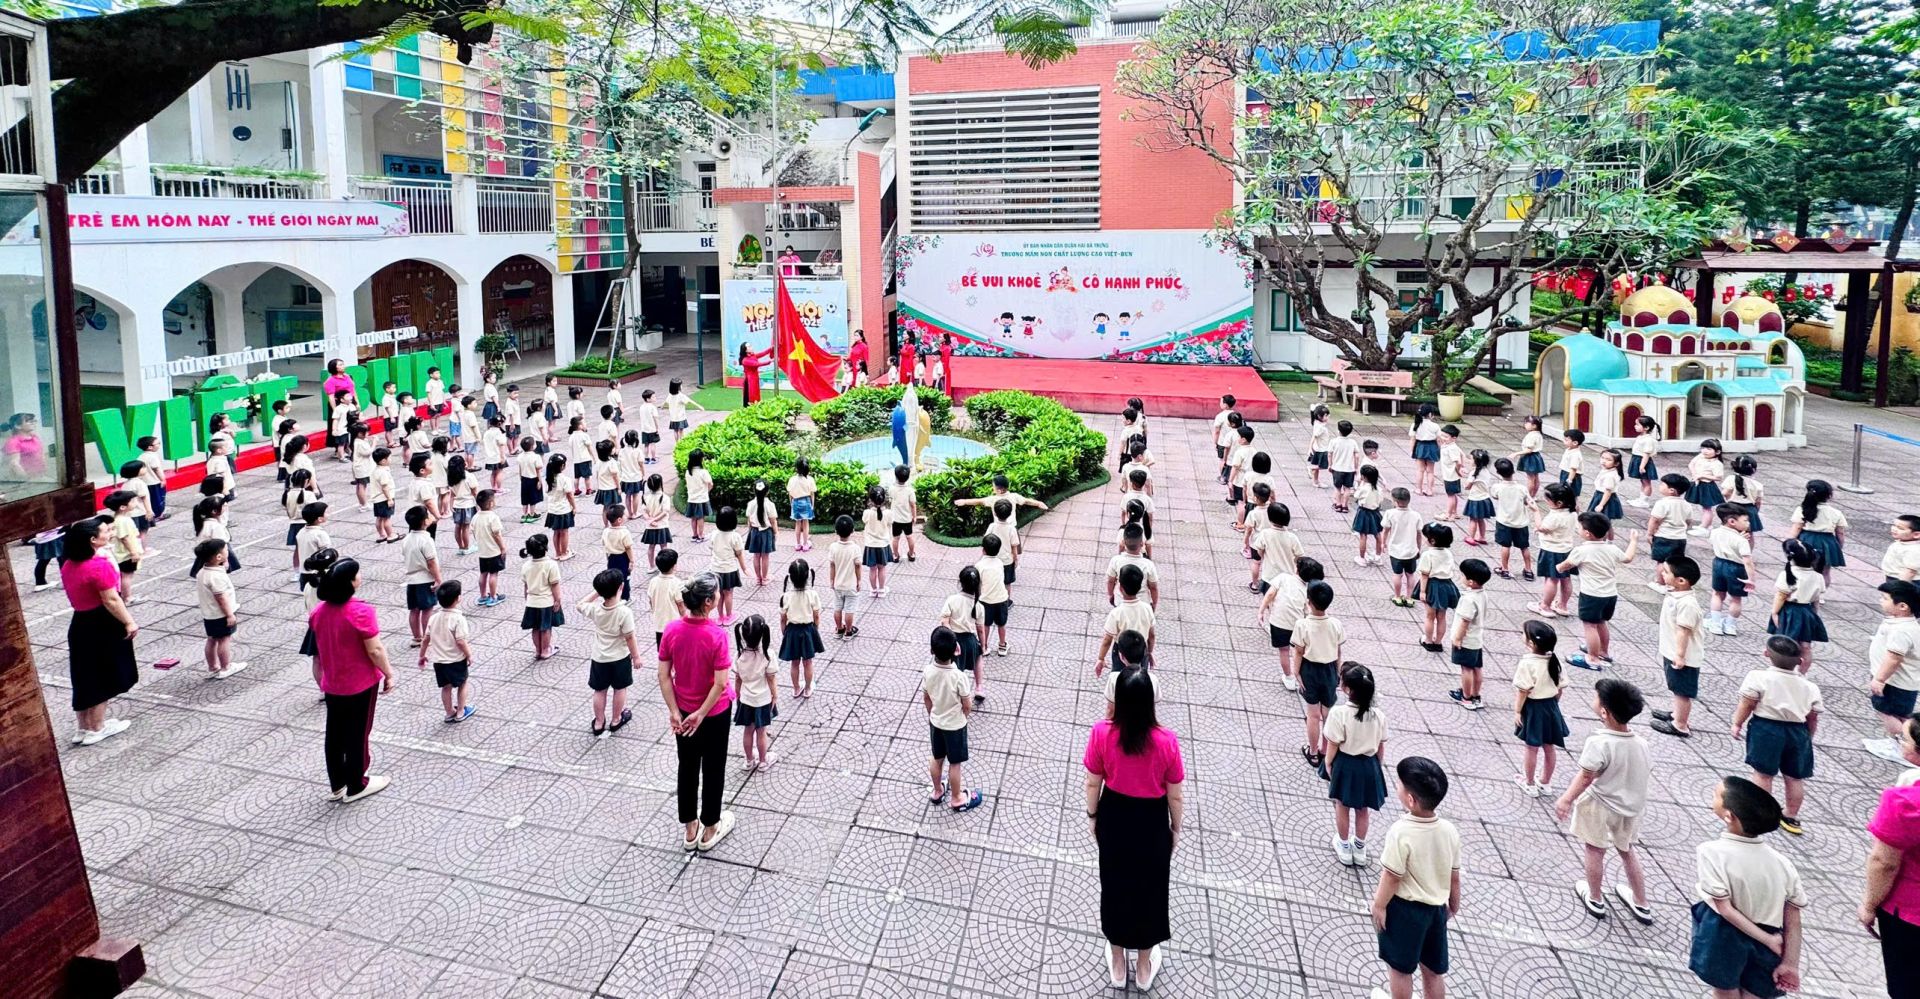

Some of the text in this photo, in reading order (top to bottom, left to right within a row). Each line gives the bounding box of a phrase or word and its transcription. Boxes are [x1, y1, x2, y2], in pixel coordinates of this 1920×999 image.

[111, 214, 140, 227] EM
[147, 212, 192, 227] HÔM
[198, 214, 231, 227] NAY
[248, 212, 276, 226] THẾ
[357, 215, 379, 226] MAI
[961, 273, 978, 287] BÉ
[982, 276, 1004, 288] VUI
[1082, 273, 1100, 289] CÔ
[1105, 276, 1141, 292] HẠNH
[1145, 274, 1184, 290] PHÚC
[272, 344, 305, 360] NON
